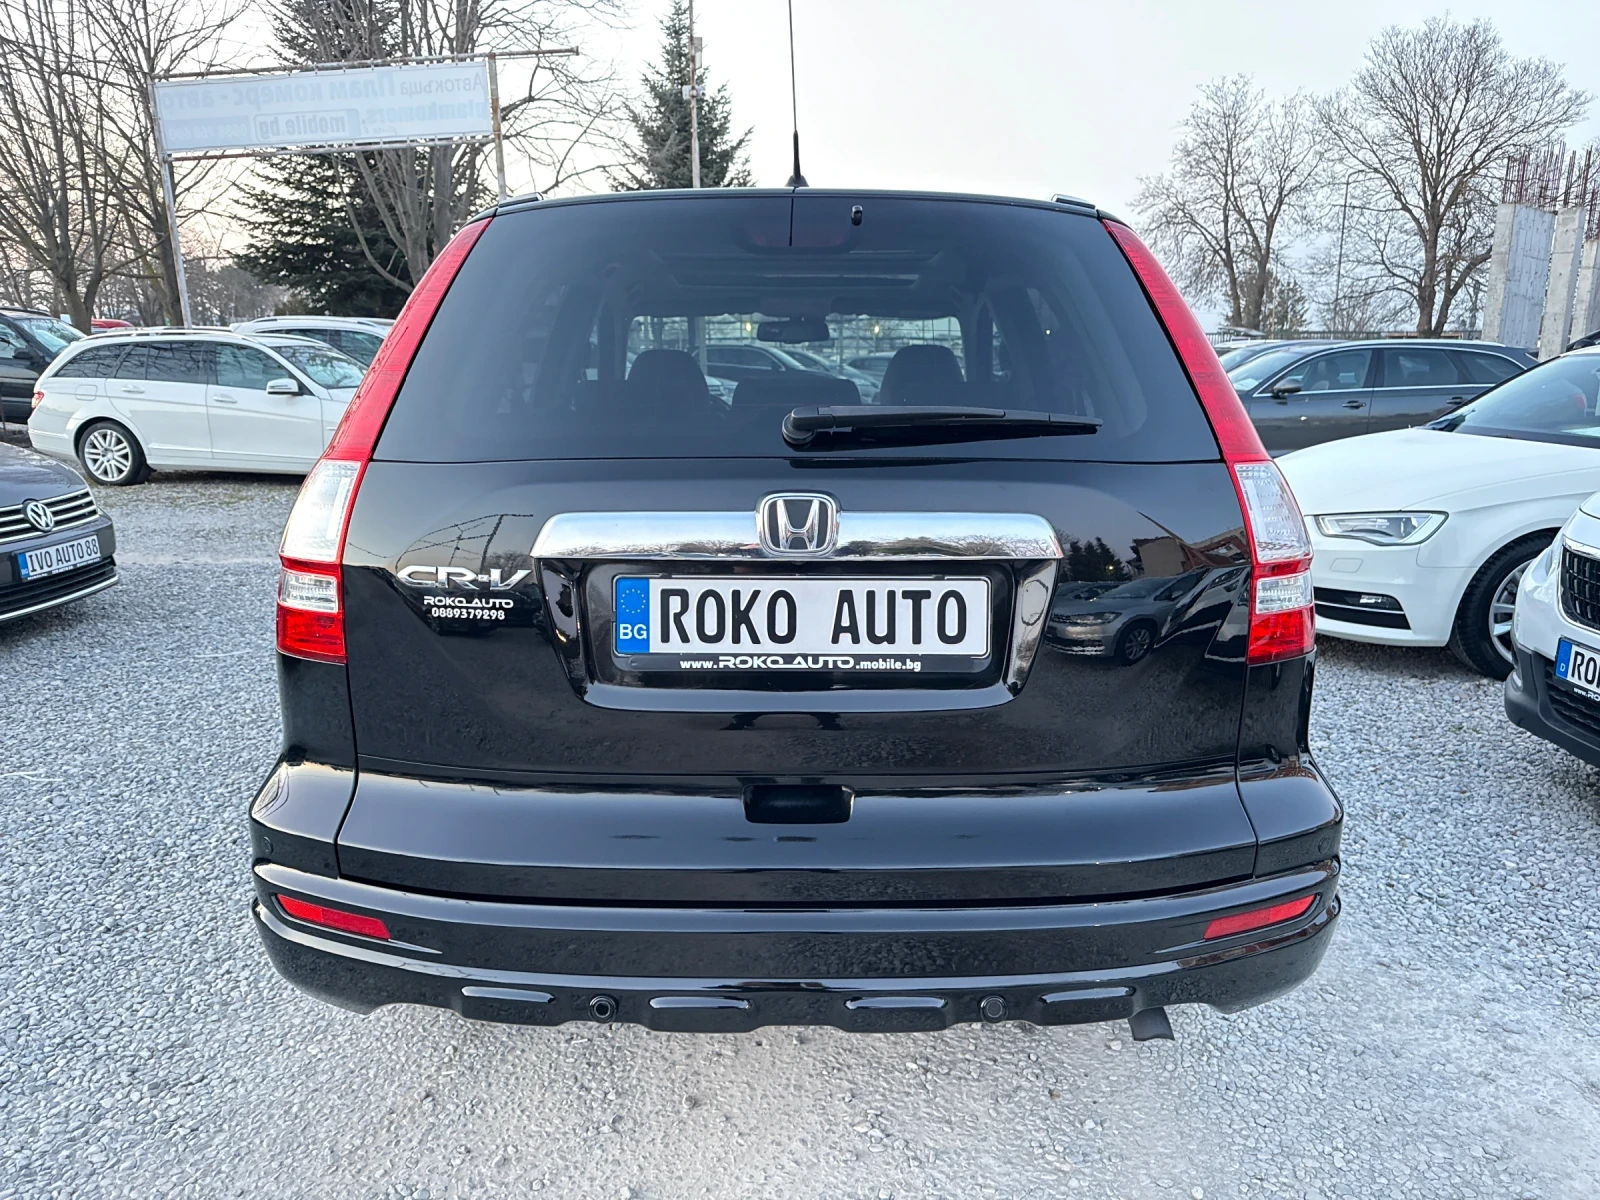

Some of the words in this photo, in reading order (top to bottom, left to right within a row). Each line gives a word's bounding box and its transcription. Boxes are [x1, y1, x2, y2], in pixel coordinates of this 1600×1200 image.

[28, 551, 53, 573] IVO
[56, 543, 84, 566] AUTO
[86, 538, 99, 557] 88
[397, 565, 532, 590] CR-V
[431, 607, 505, 620] 0889379298
[660, 588, 797, 644] ROKO
[831, 590, 967, 645] AUTO
[619, 623, 648, 640] BG
[1560, 663, 1566, 672] D
[1571, 650, 1600, 689] RO
